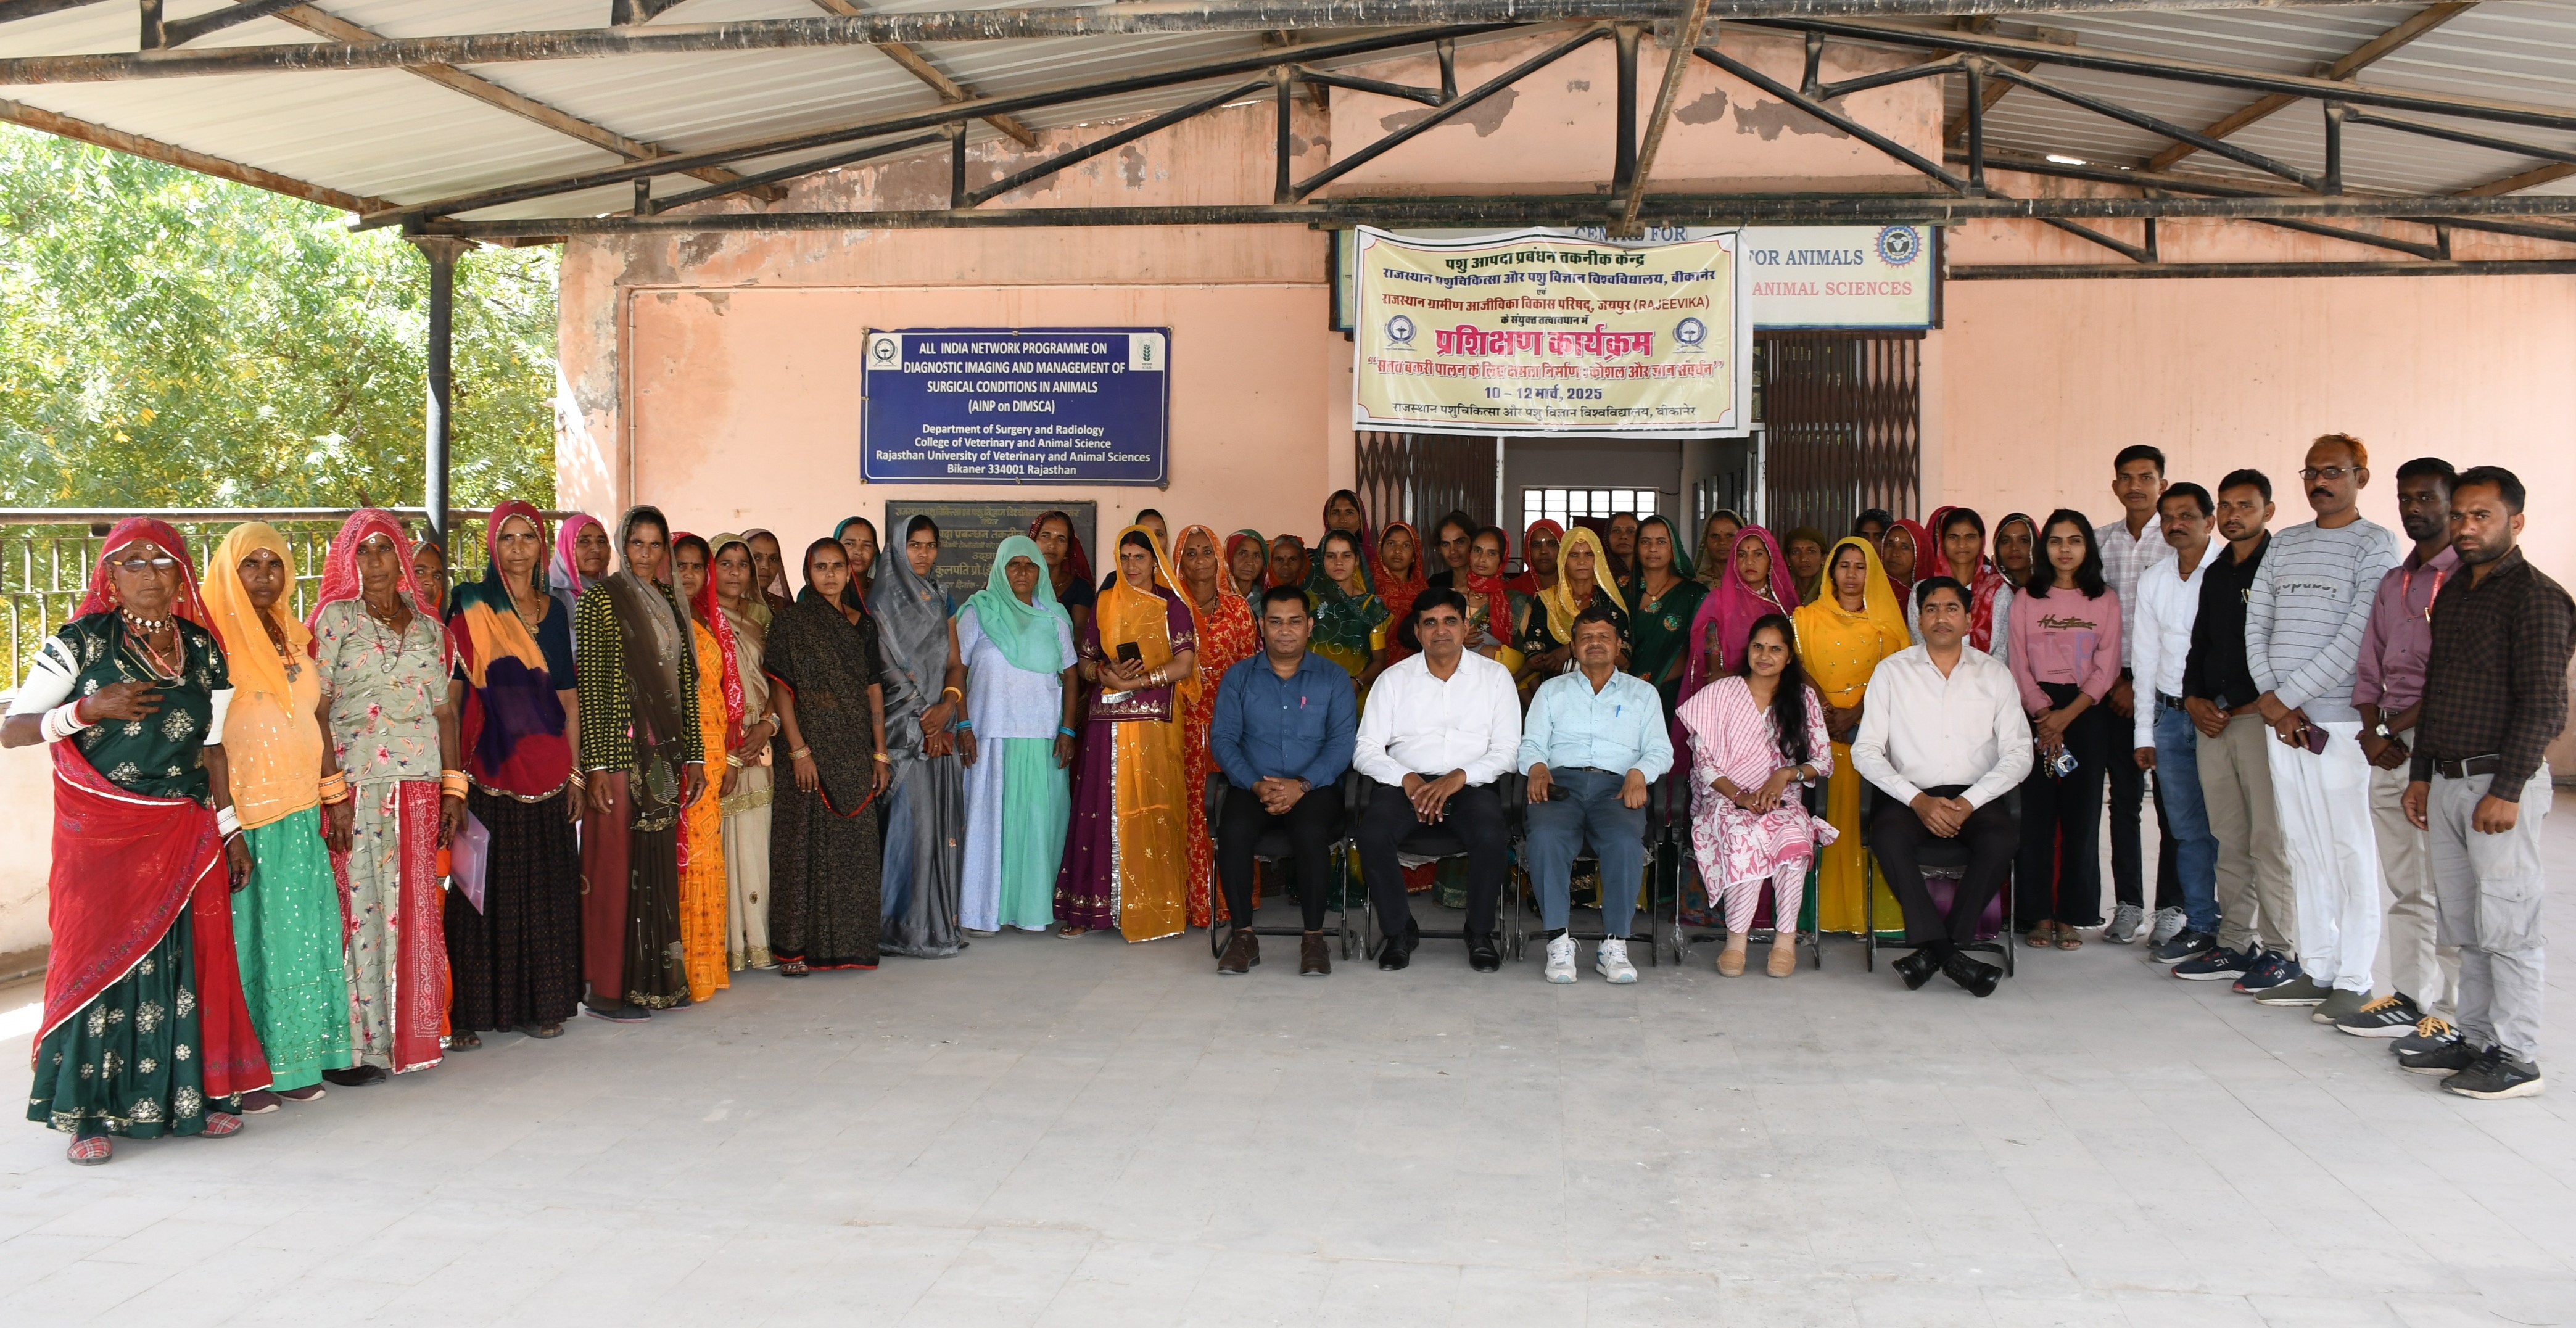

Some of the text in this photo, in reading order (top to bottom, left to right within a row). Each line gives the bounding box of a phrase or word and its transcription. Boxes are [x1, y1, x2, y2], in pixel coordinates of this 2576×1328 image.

[1651, 226, 1686, 241] FOR
[1445, 247, 1646, 273] पशु आपदा प्रबंधन तकनीक केन्द्र
[1785, 250, 1863, 265] ANIMALS
[1382, 268, 1716, 289] राजस्थान पशुचिकित्सा और पशु विज्ञान विश्वविद्यालय, बीकानेर
[1752, 281, 1912, 295] ANIMAL SCIENCES
[1382, 294, 1426, 307] राजस्थान
[1427, 298, 1464, 311] ग्रामीण
[1466, 297, 1519, 311] आजीविका
[1521, 296, 1555, 309] विकास
[1597, 300, 1631, 315] जयपुर
[1634, 295, 1709, 313] (RAJEEVIKA)
[1501, 314, 1509, 324] के
[1511, 313, 1537, 327] संयुक्त
[1581, 314, 1590, 324] में
[919, 342, 1107, 354] ALL INDIA NETWORK PROGRAMME ON
[1434, 324, 1544, 357] प्रशिक्षण
[1547, 323, 1655, 361] कार्यक्रम
[904, 361, 1125, 374] DIAGNOSTIC IMAGING AND MANAGEMENT OF
[1405, 360, 1434, 376] बकरी
[1435, 363, 1468, 378] पालन
[1468, 361, 1480, 379] के
[1482, 361, 1505, 379] लिए
[1507, 365, 1542, 379] क्षमता
[1542, 362, 1580, 380] निर्माण
[1589, 362, 1626, 380] कौशल
[1628, 361, 1651, 379] और
[1651, 364, 1676, 379] ज्ञान
[927, 381, 1098, 393] SURGICAL CONDITIONS IN ANIMALS
[1484, 387, 1501, 398] 10
[1517, 387, 1532, 399] 12
[1535, 385, 1563, 402] मार्च,
[1567, 387, 1603, 400] 2025
[968, 399, 1055, 414] (AINP on DIMSCA)
[1392, 403, 1697, 421] राजस्थान पशुचिकित्सा और पशु विज्ञान विश्वविद्यालय, बीकानेर
[923, 424, 1104, 437] Department of Surgery and Radiology
[914, 437, 1112, 449] College of Veterinary and Animal Science
[876, 450, 1150, 463] Rajasthan University of Veterinary and Animal Sciences
[947, 463, 1076, 477] Bikaner 334001 Rajasthan
[935, 562, 970, 578] कुलपति
